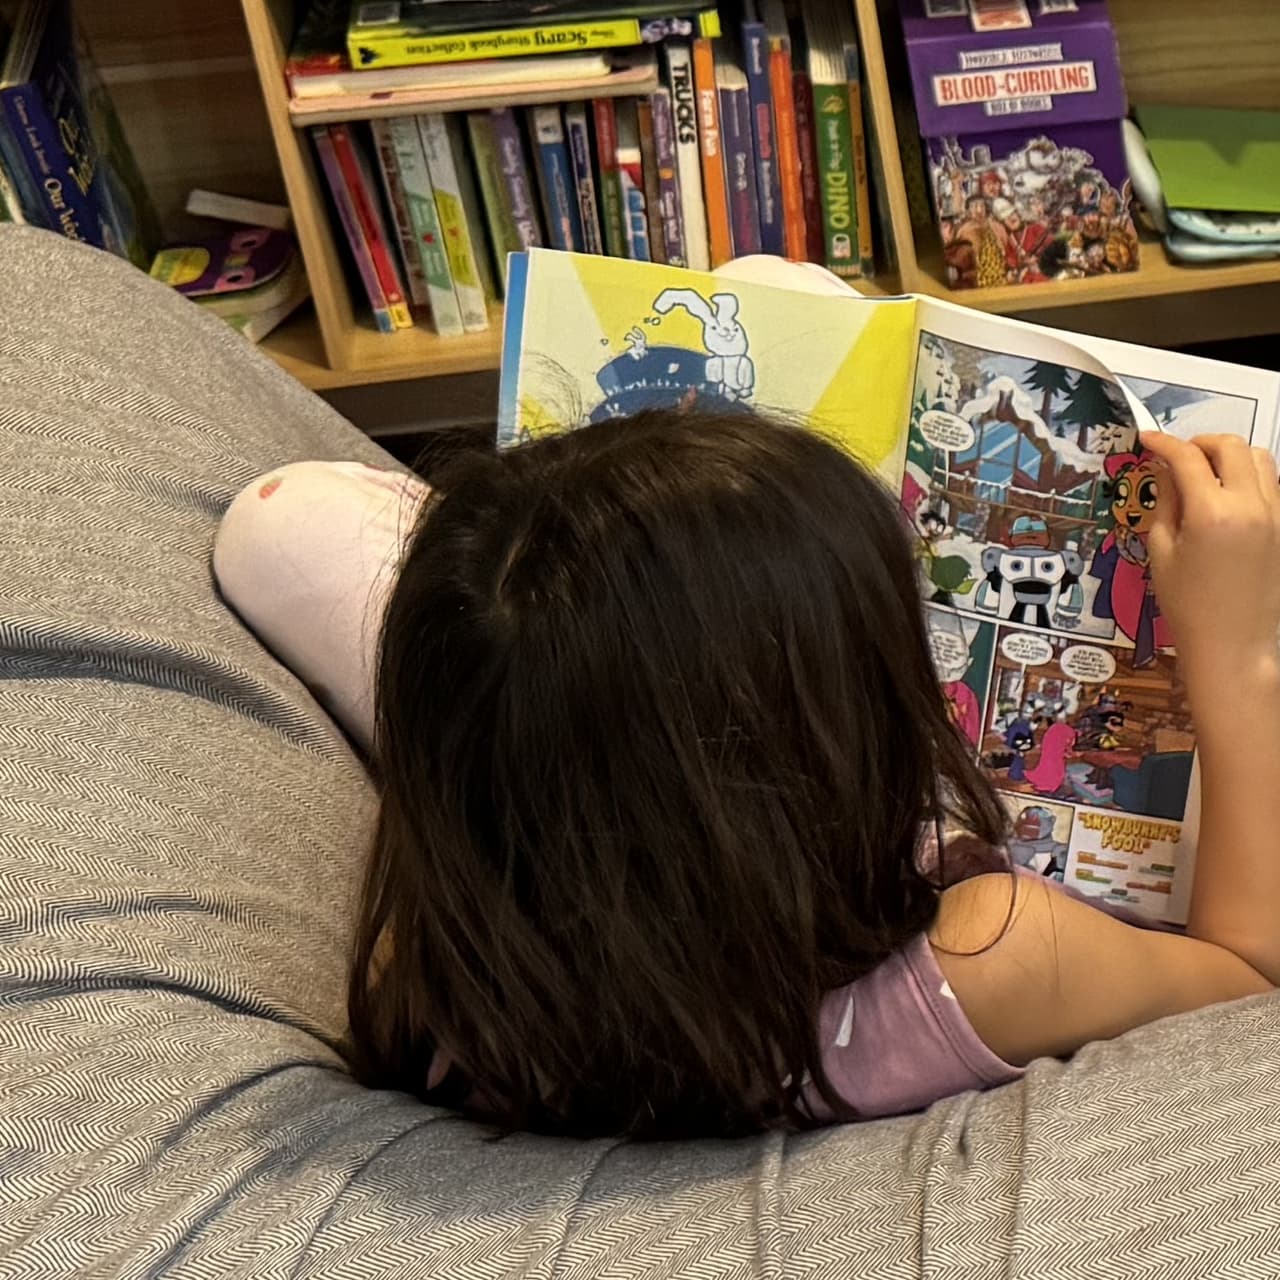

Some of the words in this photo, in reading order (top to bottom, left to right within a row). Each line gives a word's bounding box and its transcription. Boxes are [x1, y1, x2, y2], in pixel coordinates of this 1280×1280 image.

[406, 40, 466, 53] Collection
[481, 36, 532, 50] Storybook
[534, 31, 588, 45] Scary
[940, 66, 1090, 102] BLOOD-CURDLING
[672, 62, 694, 145] TRUCKS
[700, 90, 716, 128] Farm
[704, 131, 718, 157] Fun
[41, 174, 70, 212] Our
[825, 171, 850, 230] DINO
